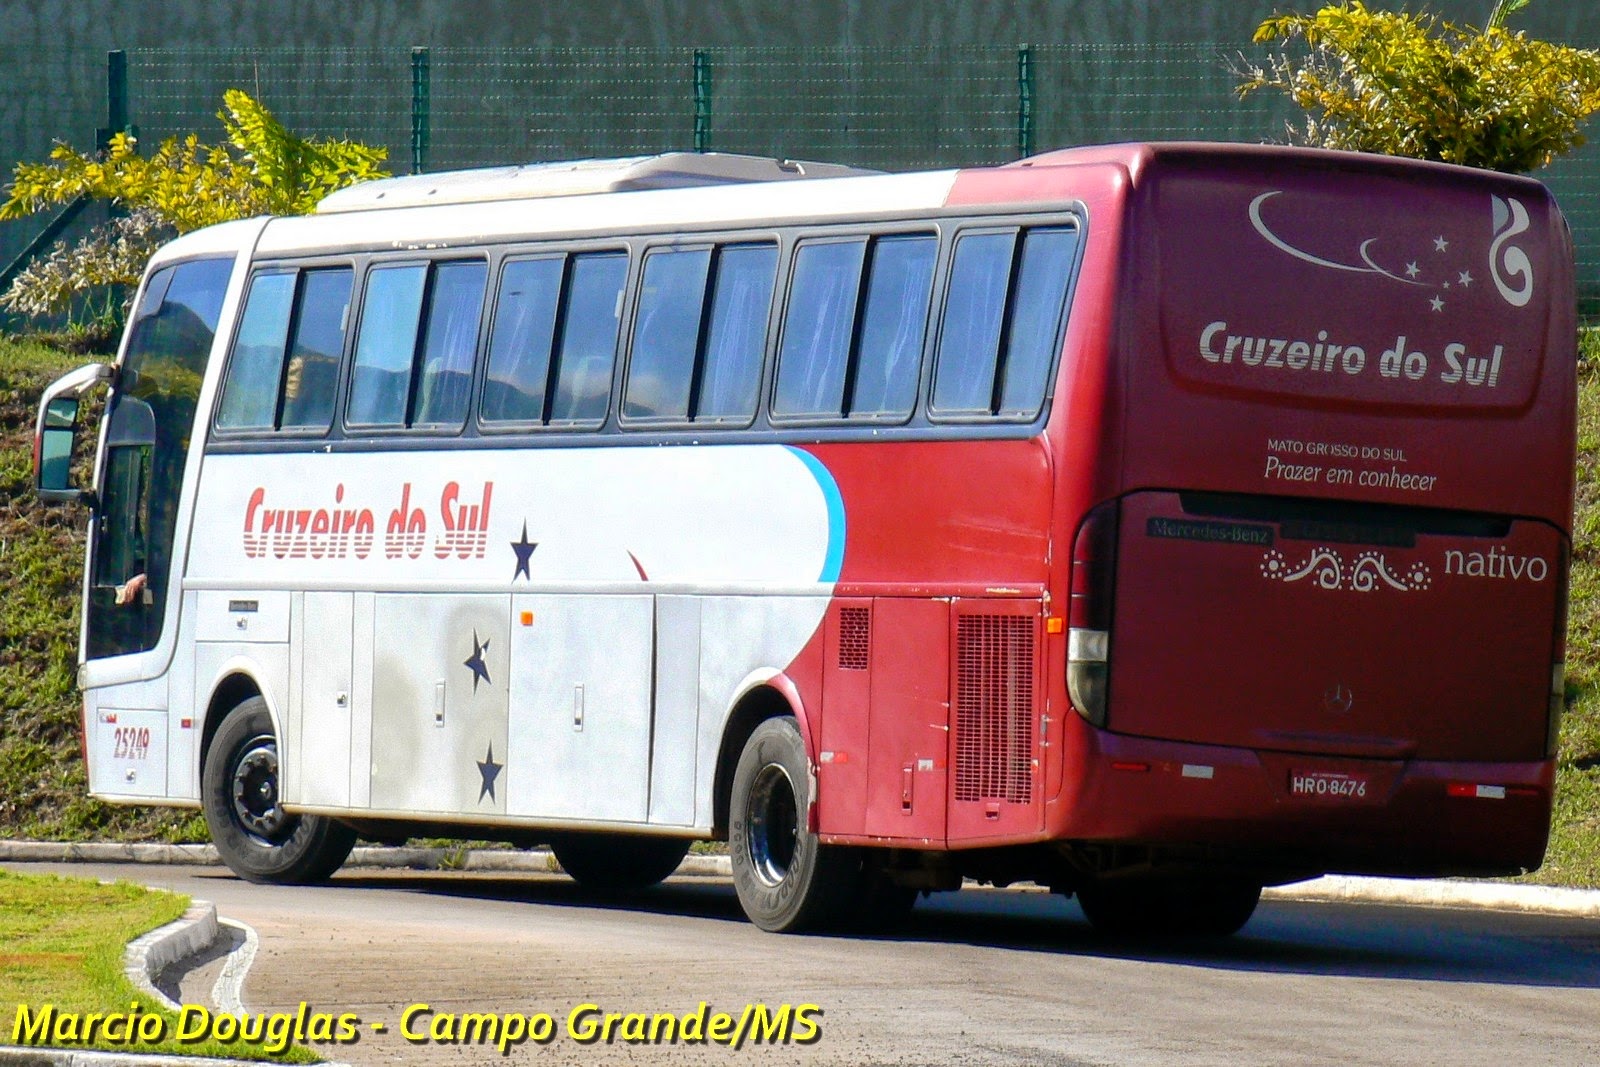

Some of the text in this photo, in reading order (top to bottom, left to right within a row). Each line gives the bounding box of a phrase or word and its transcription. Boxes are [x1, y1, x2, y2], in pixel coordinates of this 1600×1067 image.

[1199, 321, 1503, 388] Cruzeiro do Sul
[1267, 438, 1408, 463] MATO GROSSO DO SUL
[1264, 455, 1437, 491] Prazer em conhecer
[243, 481, 493, 560] Cruzeiro do Sul
[1150, 518, 1269, 543] Mercedes-Benz
[1444, 546, 1548, 582] nativo
[113, 727, 150, 760] 25249
